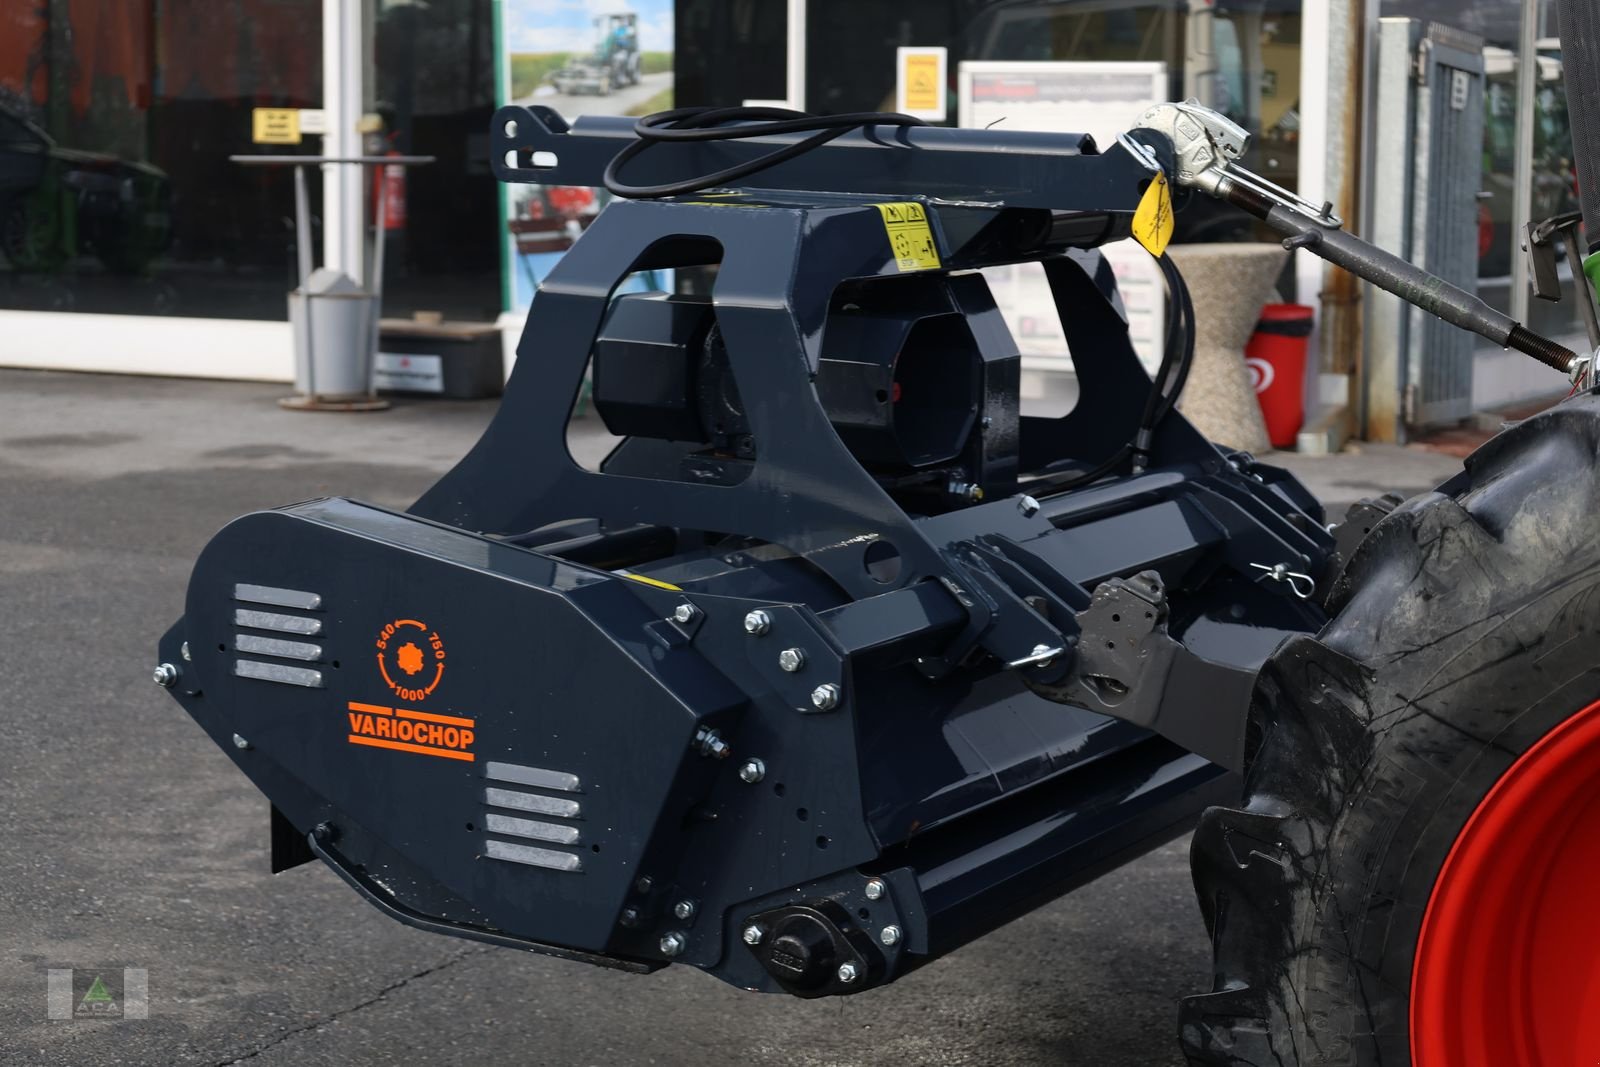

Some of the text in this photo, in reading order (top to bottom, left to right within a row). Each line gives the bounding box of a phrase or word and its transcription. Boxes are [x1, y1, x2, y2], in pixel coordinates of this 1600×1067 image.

[376, 623, 396, 650] 540
[428, 632, 446, 659] 750
[395, 685, 425, 701] 1000
[348, 712, 475, 749] VARIOCHOP
